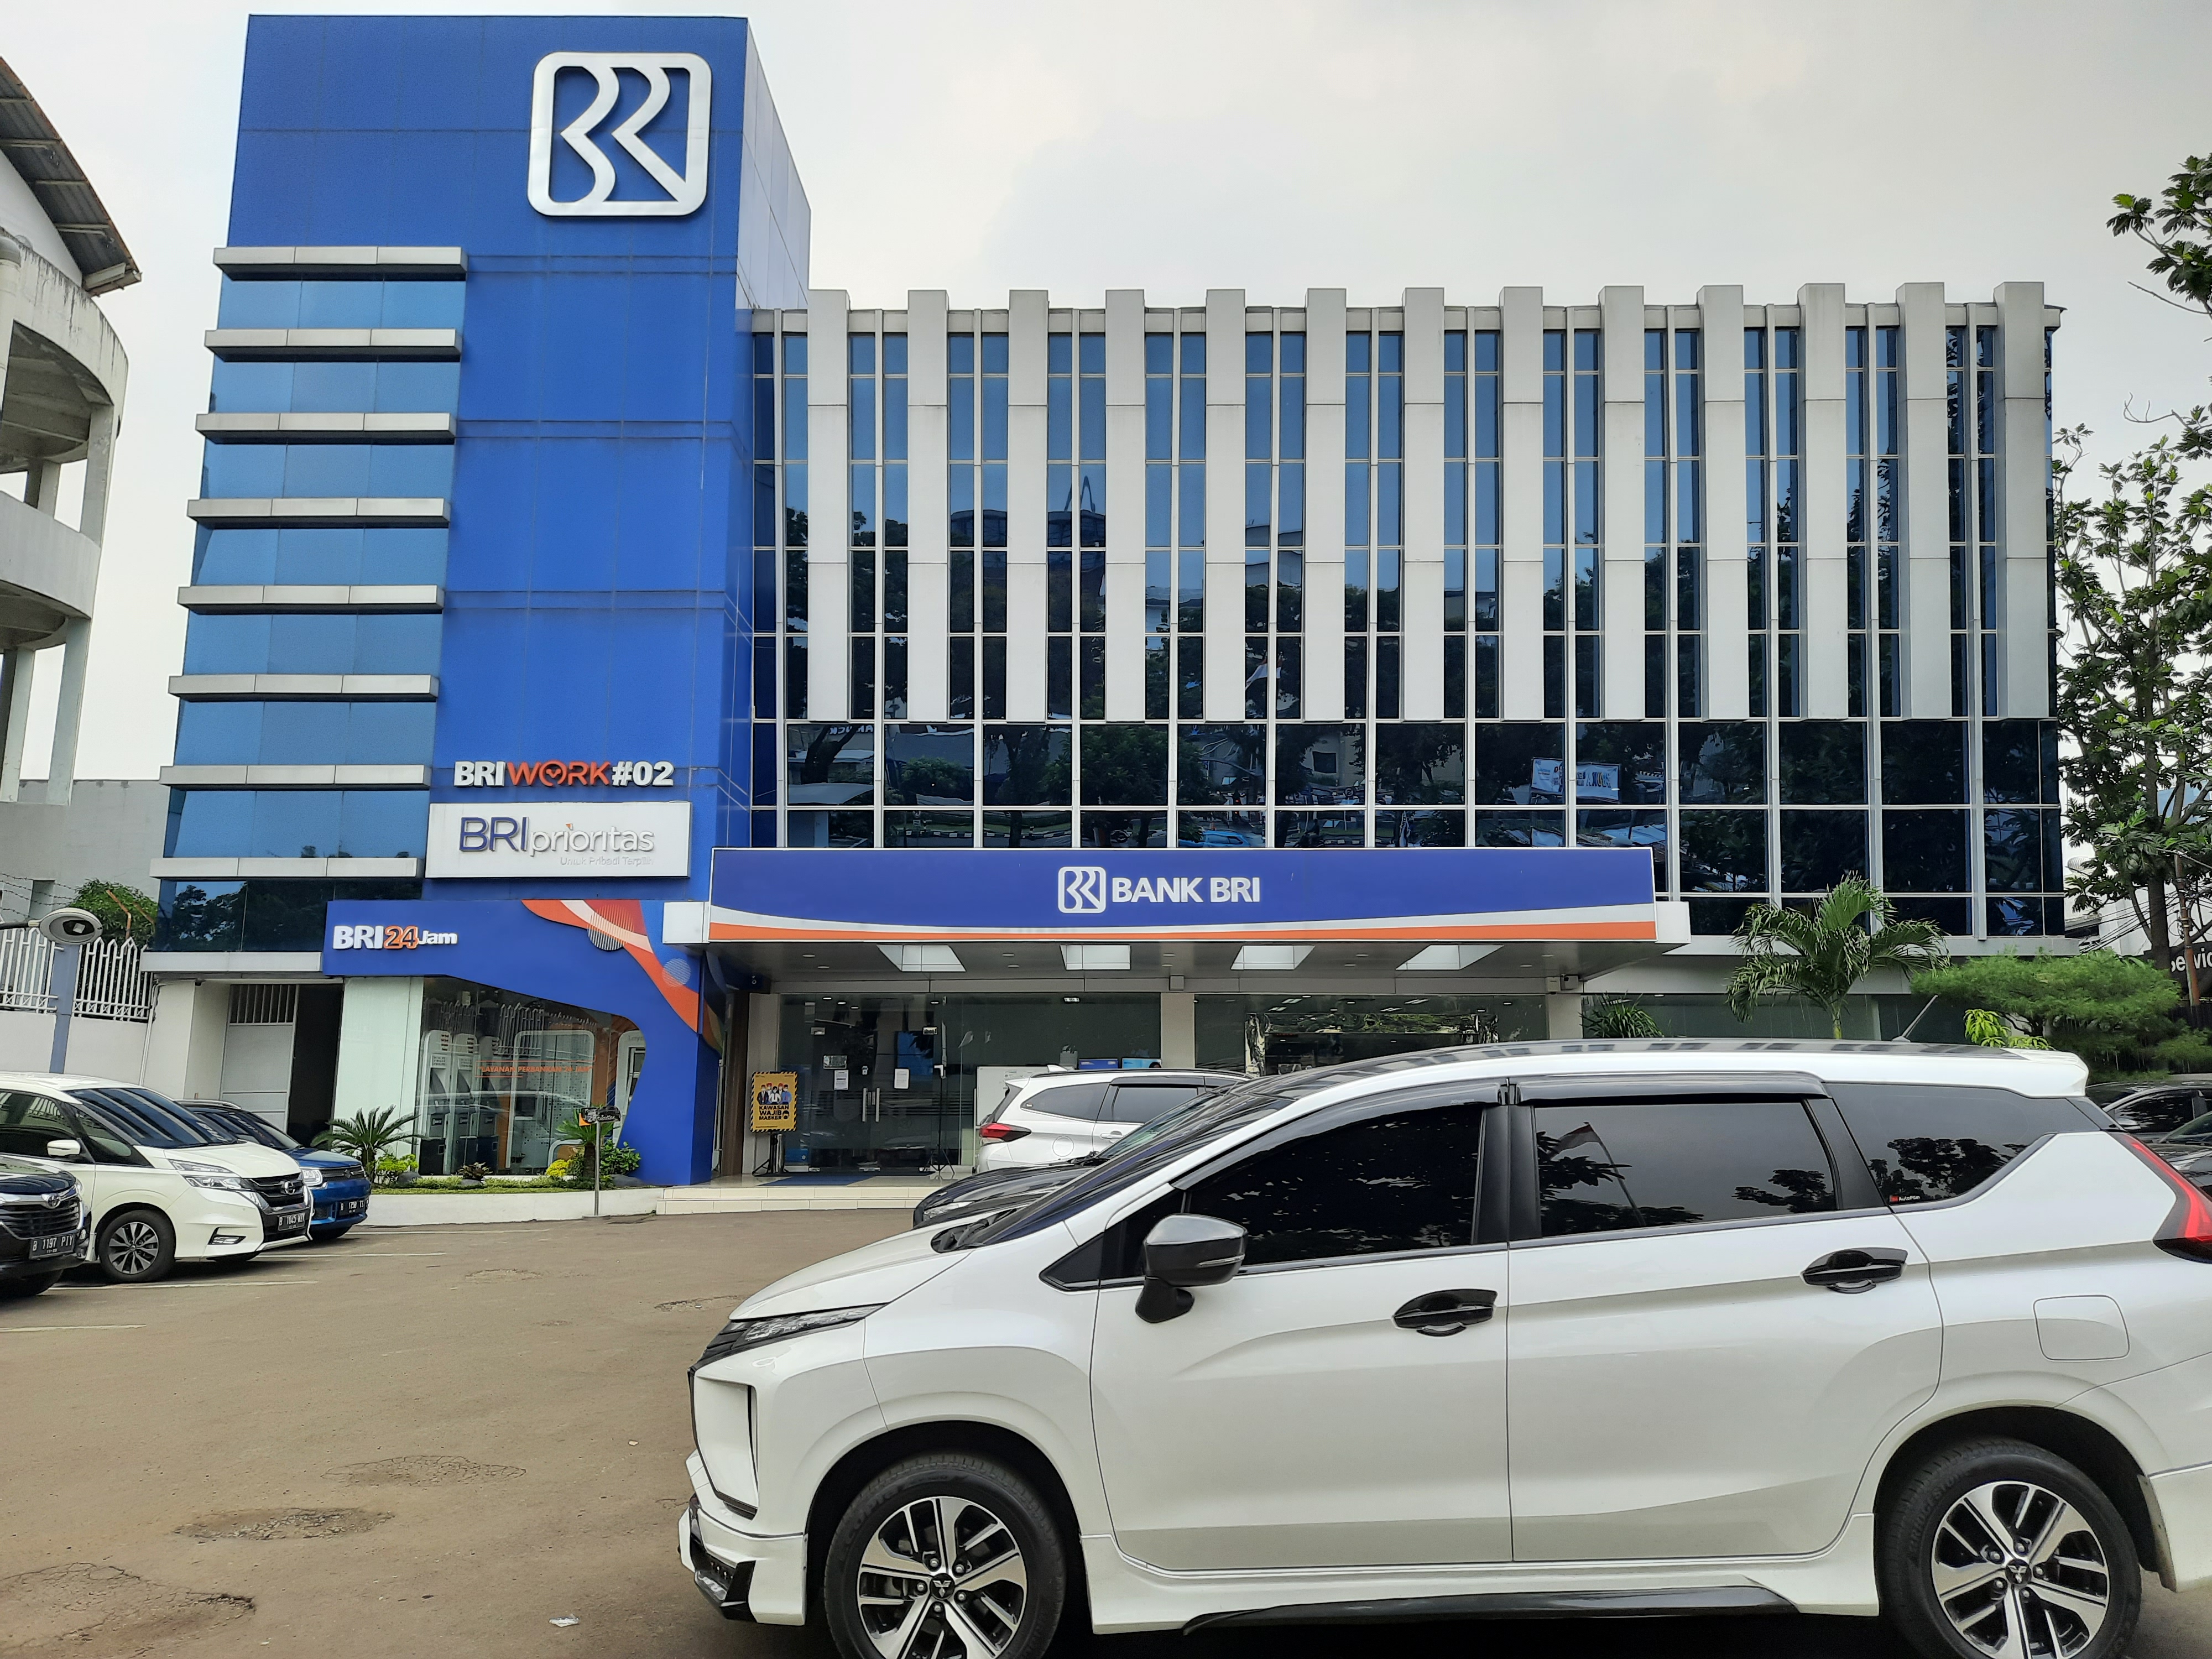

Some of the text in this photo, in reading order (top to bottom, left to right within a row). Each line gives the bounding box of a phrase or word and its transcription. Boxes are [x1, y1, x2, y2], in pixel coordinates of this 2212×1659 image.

[1112, 877, 1260, 902] BANK BRI
[279, 1217, 283, 1226] B
[32, 1235, 74, 1251] B 1197 PIY
